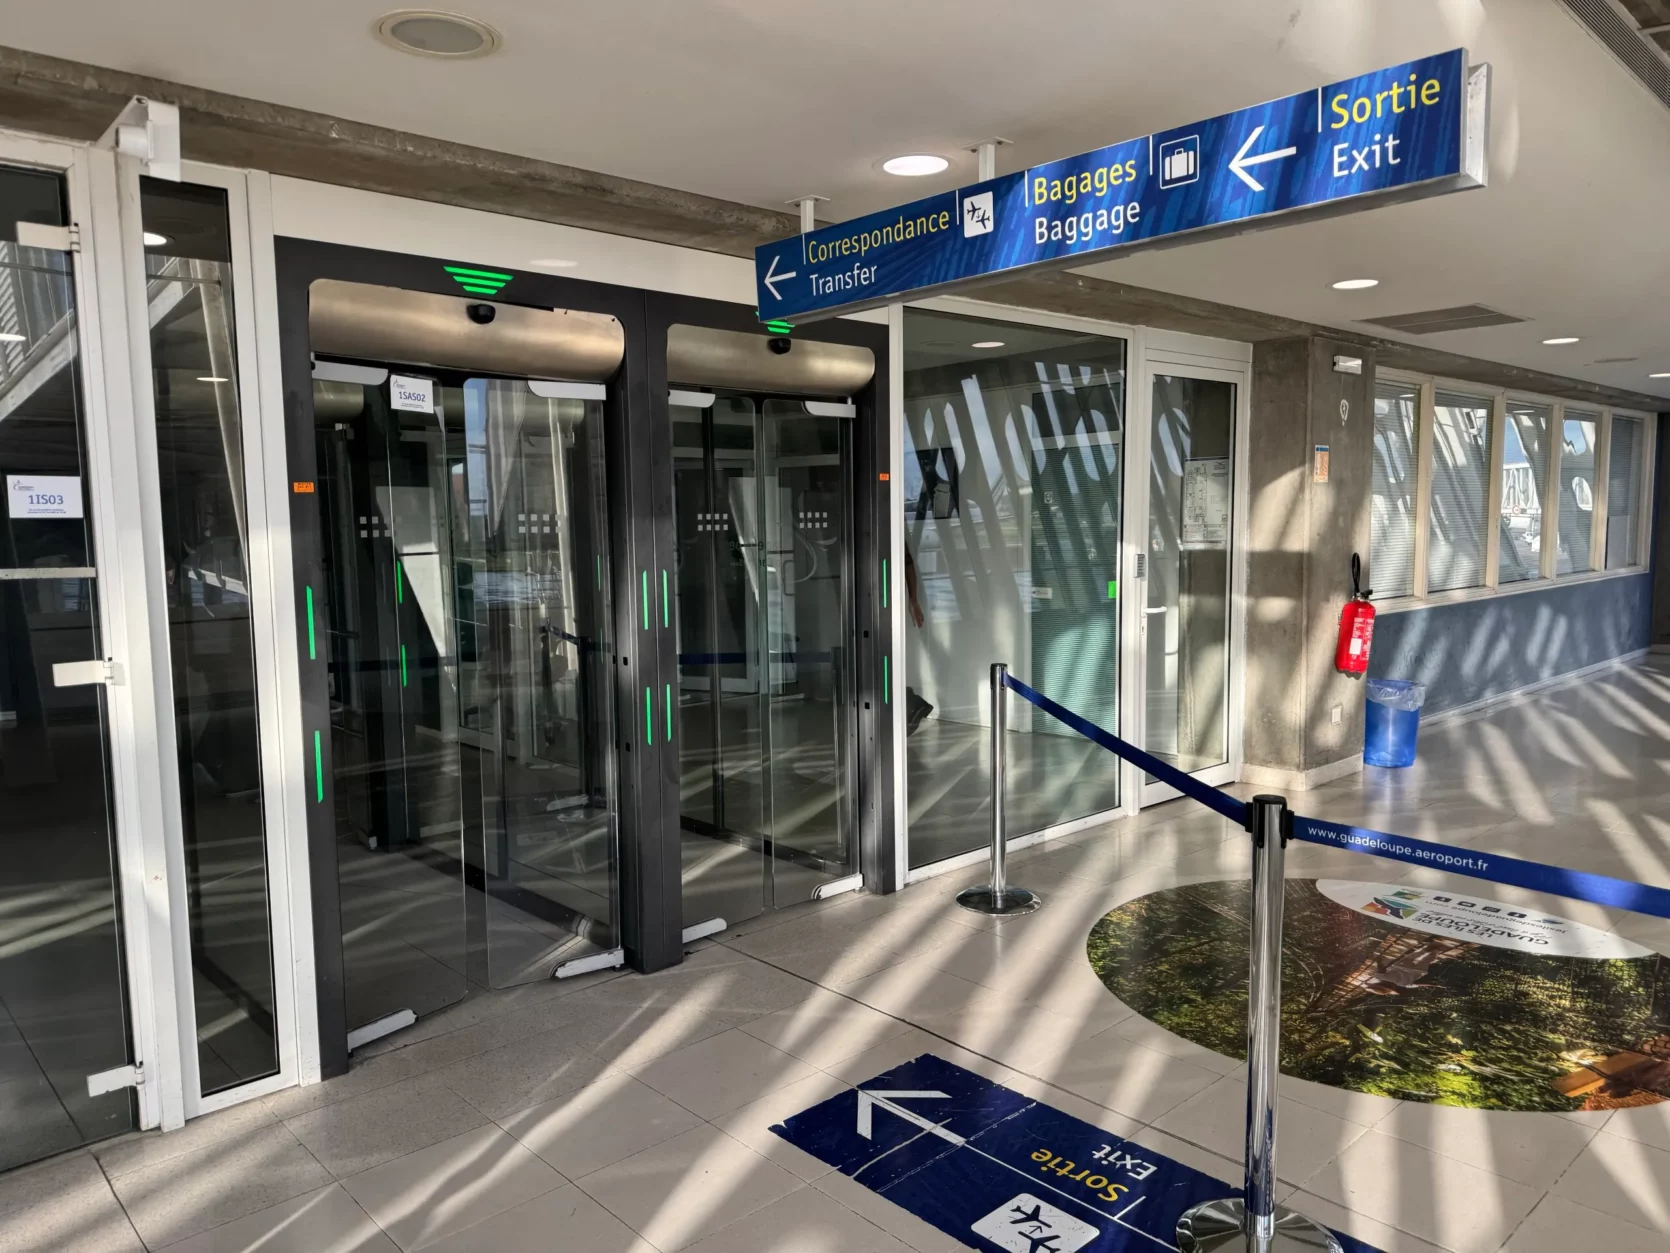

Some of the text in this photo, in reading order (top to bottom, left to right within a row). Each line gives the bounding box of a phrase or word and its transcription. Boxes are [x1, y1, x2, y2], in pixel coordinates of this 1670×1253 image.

[1331, 73, 1441, 129] Sortie
[1333, 133, 1401, 177] Exit
[1034, 159, 1137, 205] Bagages
[808, 211, 950, 264] Correspondance
[1035, 201, 1140, 245] Baggage
[809, 262, 878, 296] Transfer
[398, 391, 426, 403] 1SAS02
[28, 494, 64, 505] 1IS03
[1307, 825, 1489, 871] www.guadeloupe.aeroport.fr
[1420, 912, 1549, 945] GUADELOUPE
[1425, 900, 1566, 934] lesilesdeguadeloupecom
[1031, 1149, 1130, 1201] Sortie
[1091, 1144, 1158, 1180] Exit
